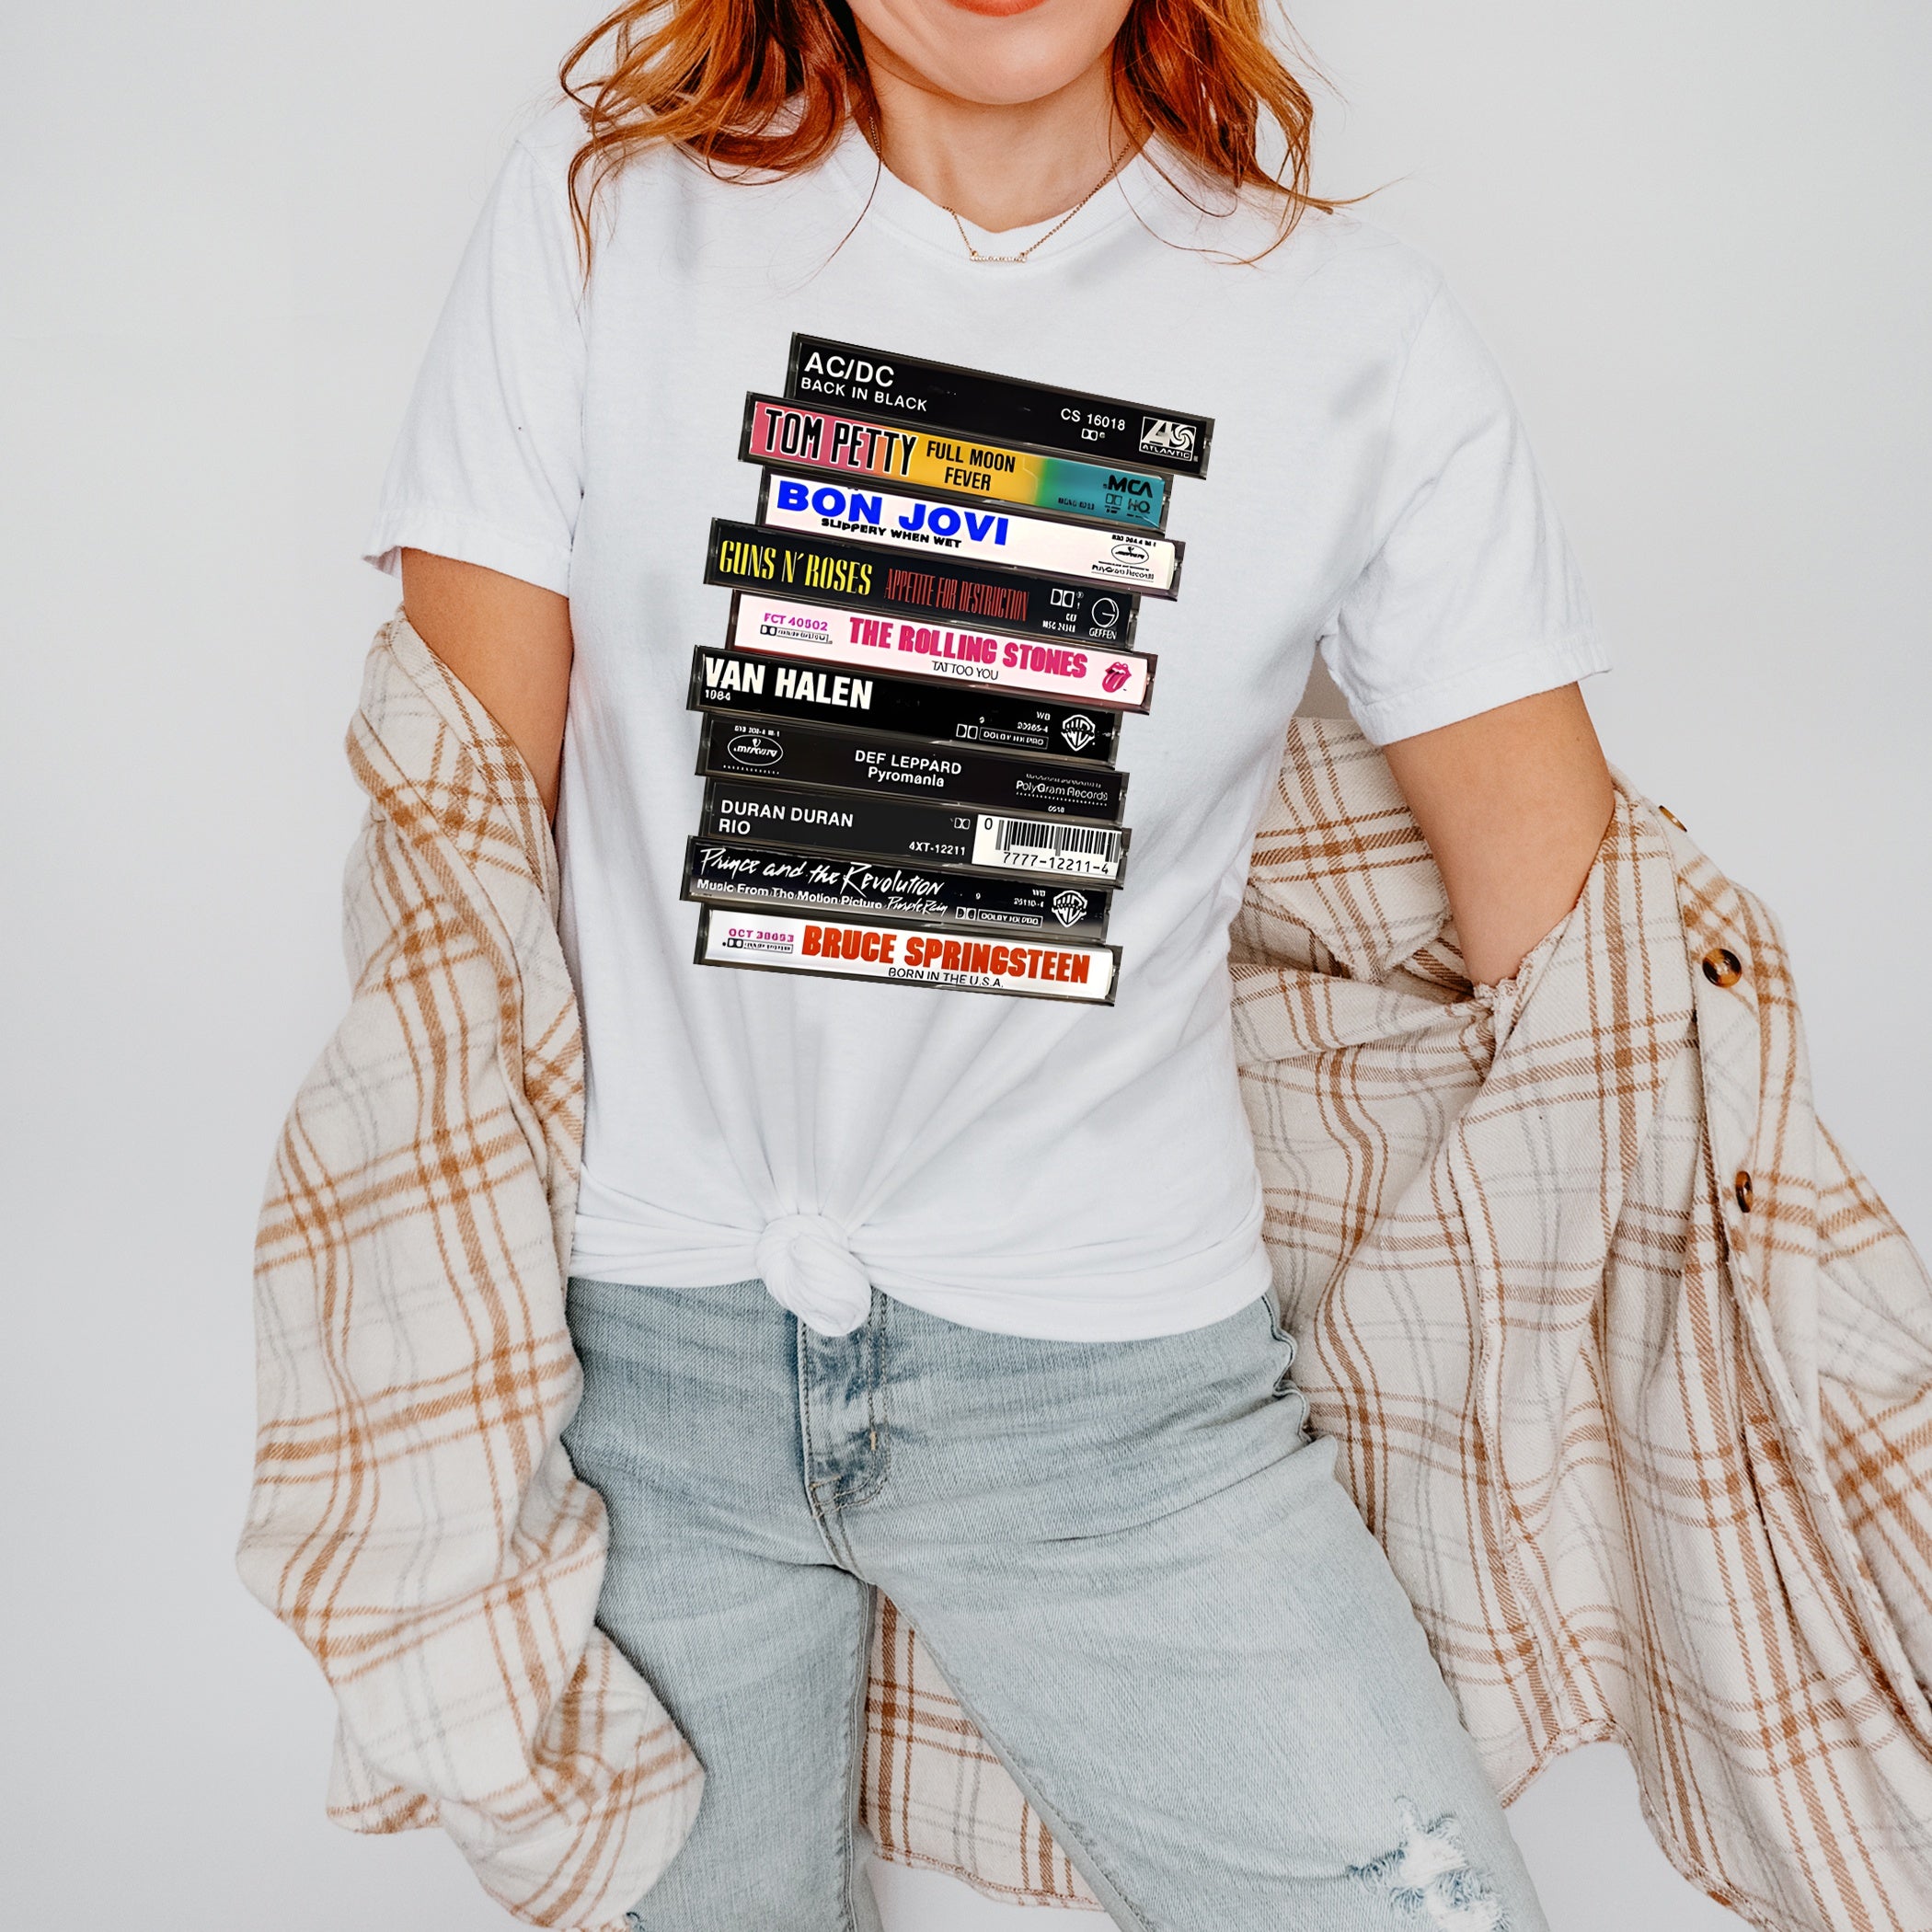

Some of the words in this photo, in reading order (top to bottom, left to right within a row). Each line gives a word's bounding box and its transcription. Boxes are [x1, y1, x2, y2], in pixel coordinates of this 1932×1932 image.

[804, 351, 894, 387] AC/DC
[800, 377, 845, 397] BACK
[852, 386, 868, 400] IN
[874, 391, 927, 412] BLACK
[1061, 408, 1081, 422] CS
[1087, 413, 1126, 431] 16018
[765, 407, 824, 460] TOM
[830, 420, 918, 477] PETTY
[926, 440, 964, 463] FULL
[970, 448, 1016, 473] MOON
[944, 466, 992, 491] FEVER
[1108, 475, 1153, 499] MCA
[776, 480, 882, 524] BON
[898, 503, 1009, 546] JOVI
[821, 518, 886, 536] SLIPPERY
[891, 529, 929, 543] WHEN
[933, 535, 961, 548] WET
[719, 540, 776, 580] GUNS
[805, 554, 872, 596] ROSES
[884, 569, 935, 607] APPETITE
[936, 577, 958, 610] FOR
[959, 581, 1030, 622] DESTRUCTION
[764, 613, 787, 625] FCT
[1089, 627, 1117, 639] GEFFEN
[849, 617, 893, 650] THE
[898, 625, 997, 664] ROLLING
[1003, 642, 1088, 679] STONES
[705, 657, 765, 695] VAN
[775, 667, 873, 710] HALEN
[932, 661, 974, 677] TATTOO
[976, 667, 999, 681] YOU
[855, 750, 886, 765] DEF
[891, 754, 961, 775] LEPPARD
[868, 766, 945, 787] Pyromania
[721, 799, 785, 820] DURAN
[790, 807, 854, 828] DURAN
[984, 817, 993, 831] 0
[719, 818, 751, 835] RIO
[909, 841, 965, 856] 4XT-12211
[700, 847, 761, 879] Prince
[763, 861, 807, 878] and
[809, 864, 840, 884] the
[839, 861, 945, 898] Revolution
[1003, 852, 1110, 875] 7777-12211-4
[696, 879, 734, 892] Music
[737, 884, 774, 897] From
[772, 887, 795, 900] The
[797, 890, 838, 904] Motion
[729, 928, 753, 938] OCT
[801, 925, 897, 964] BRUCE
[904, 937, 1090, 983] SPRINGSTEEN
[888, 967, 924, 980] BORN
[926, 971, 939, 981] IN
[943, 972, 967, 984] THE
[969, 976, 1004, 988] U.S.A.
